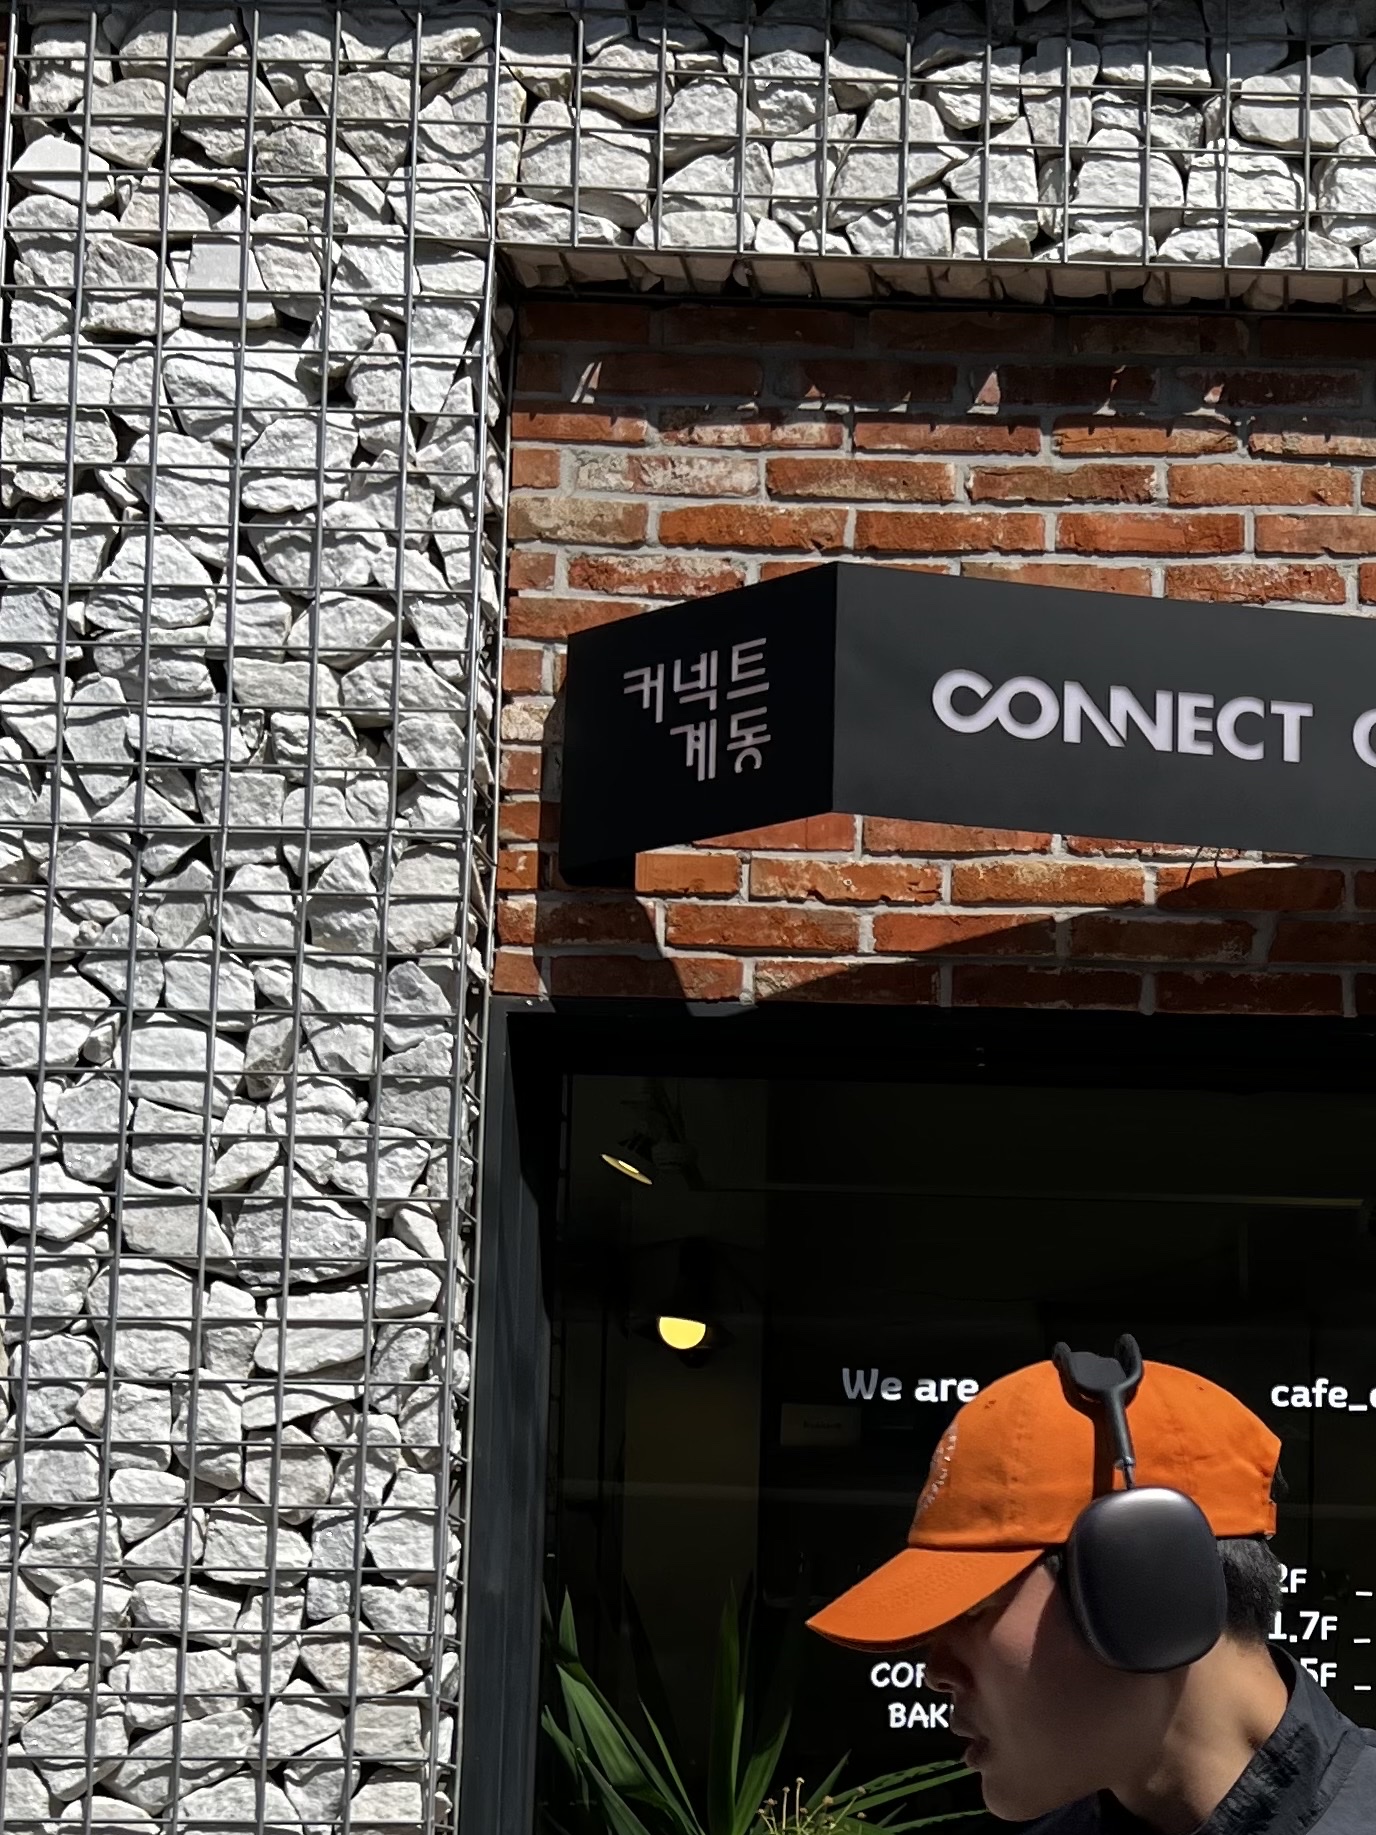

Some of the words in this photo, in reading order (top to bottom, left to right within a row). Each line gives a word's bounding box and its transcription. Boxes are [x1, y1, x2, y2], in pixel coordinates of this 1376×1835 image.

[624, 637, 770, 723] 커넥트
[932, 668, 1315, 764] CONNECT
[669, 709, 771, 783] 계동
[842, 1367, 903, 1402] We
[914, 1377, 980, 1403] are
[1267, 1610, 1338, 1643] 1.7F
[870, 1661, 927, 1689] COF
[1299, 1657, 1338, 1688] 5F
[887, 1701, 956, 1729] BAK
